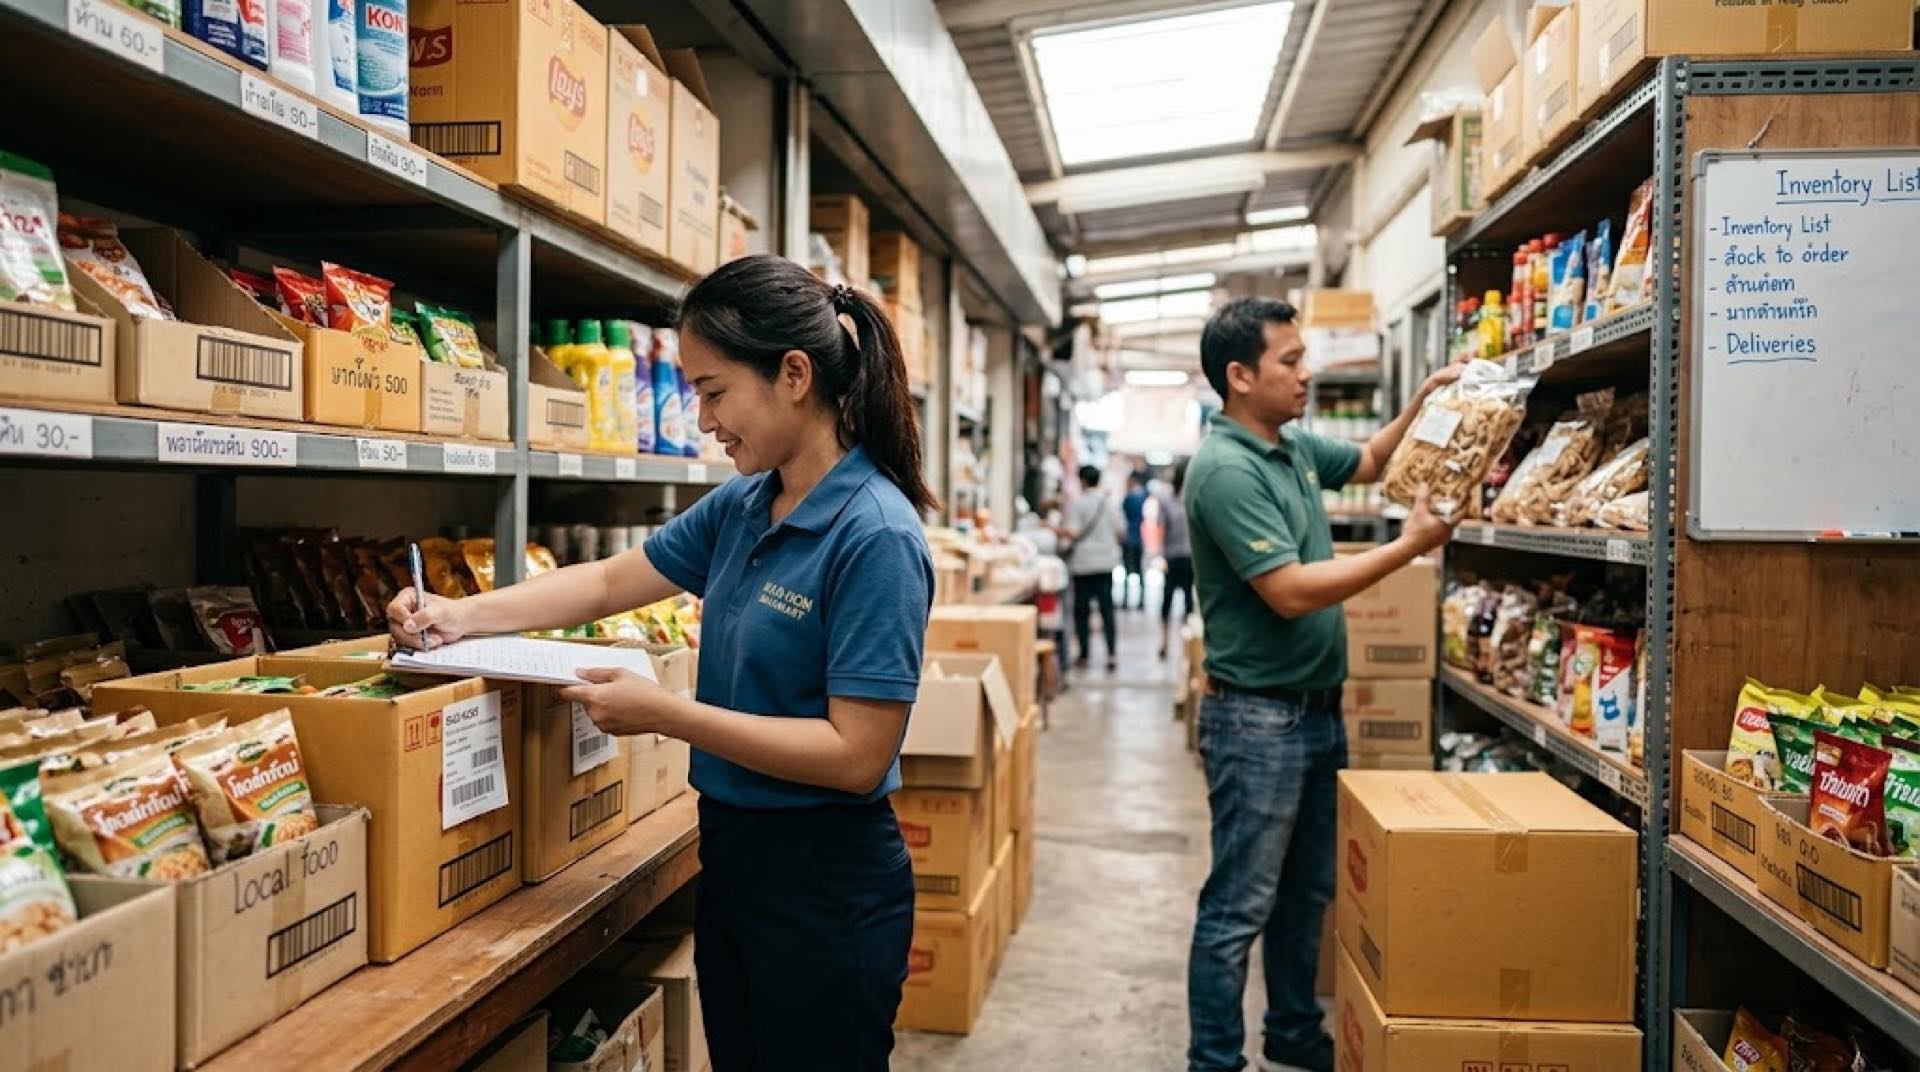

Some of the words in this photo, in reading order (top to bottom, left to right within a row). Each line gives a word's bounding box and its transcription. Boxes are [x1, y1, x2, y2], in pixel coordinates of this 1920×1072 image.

[1775, 167, 1873, 207] Inventory
[1721, 216, 1793, 242] Inventory
[1801, 214, 1832, 233] List
[1726, 332, 1817, 355] Deliveries
[385, 374, 408, 395] 500
[36, 422, 80, 450] 30.-
[233, 848, 290, 914] Local
